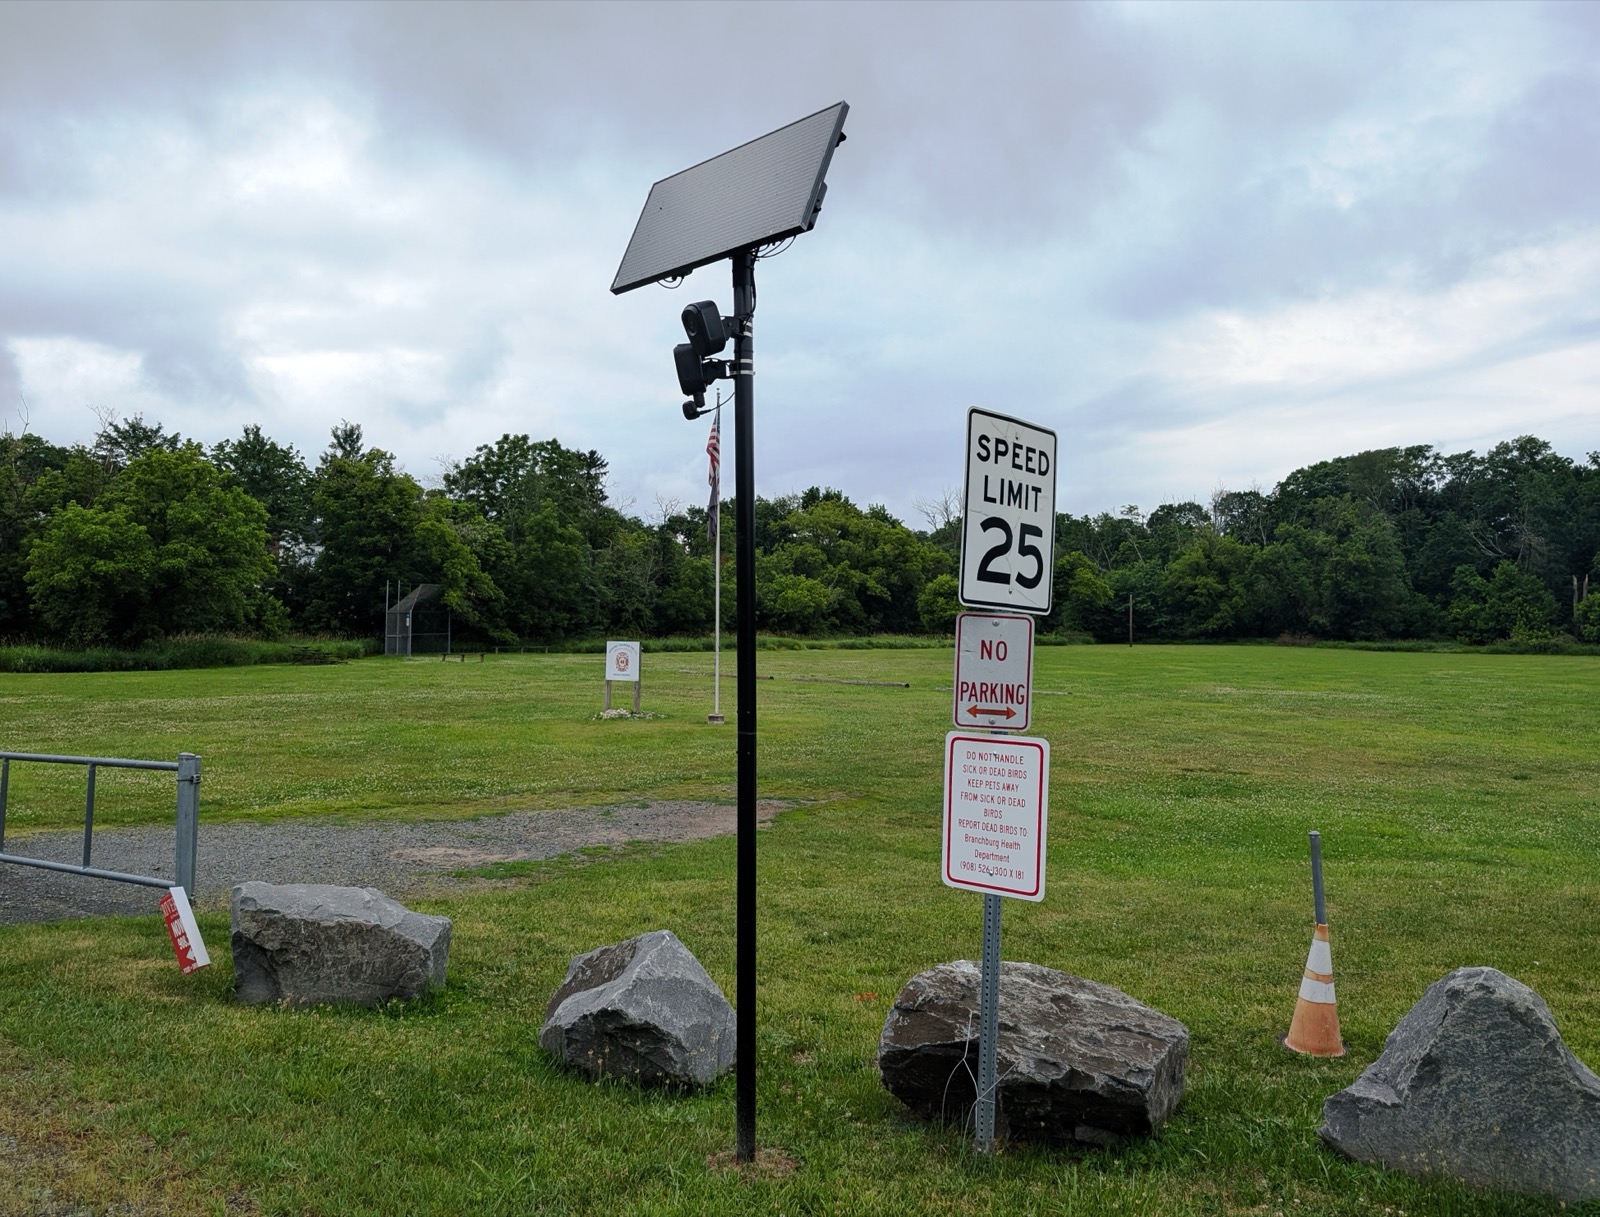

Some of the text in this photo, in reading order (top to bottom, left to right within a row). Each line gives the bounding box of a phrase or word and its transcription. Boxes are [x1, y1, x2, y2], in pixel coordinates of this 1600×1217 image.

[976, 434, 1050, 477] SPEED
[983, 474, 1042, 512] LIMIT
[977, 516, 1044, 589] 25
[980, 639, 1008, 661] NO
[960, 681, 1025, 705] PARKING
[966, 751, 1024, 765] DO NOT HANDLE
[962, 764, 1027, 779] SICK OR DEAD BIRDS
[968, 778, 1019, 792] KEEP PETS AWAY
[961, 791, 1025, 808] FROM SICK OR DEAD
[984, 808, 1002, 819] BIRDS
[958, 819, 980, 831] REPORT
[982, 822, 998, 833] DEAD
[1000, 825, 1018, 836] BIRDS
[965, 834, 1020, 850] Branchburg Health
[975, 849, 1010, 863] Department
[960, 861, 976, 871] (908)
[1009, 869, 1013, 878] X
[1015, 870, 1024, 880] 181
